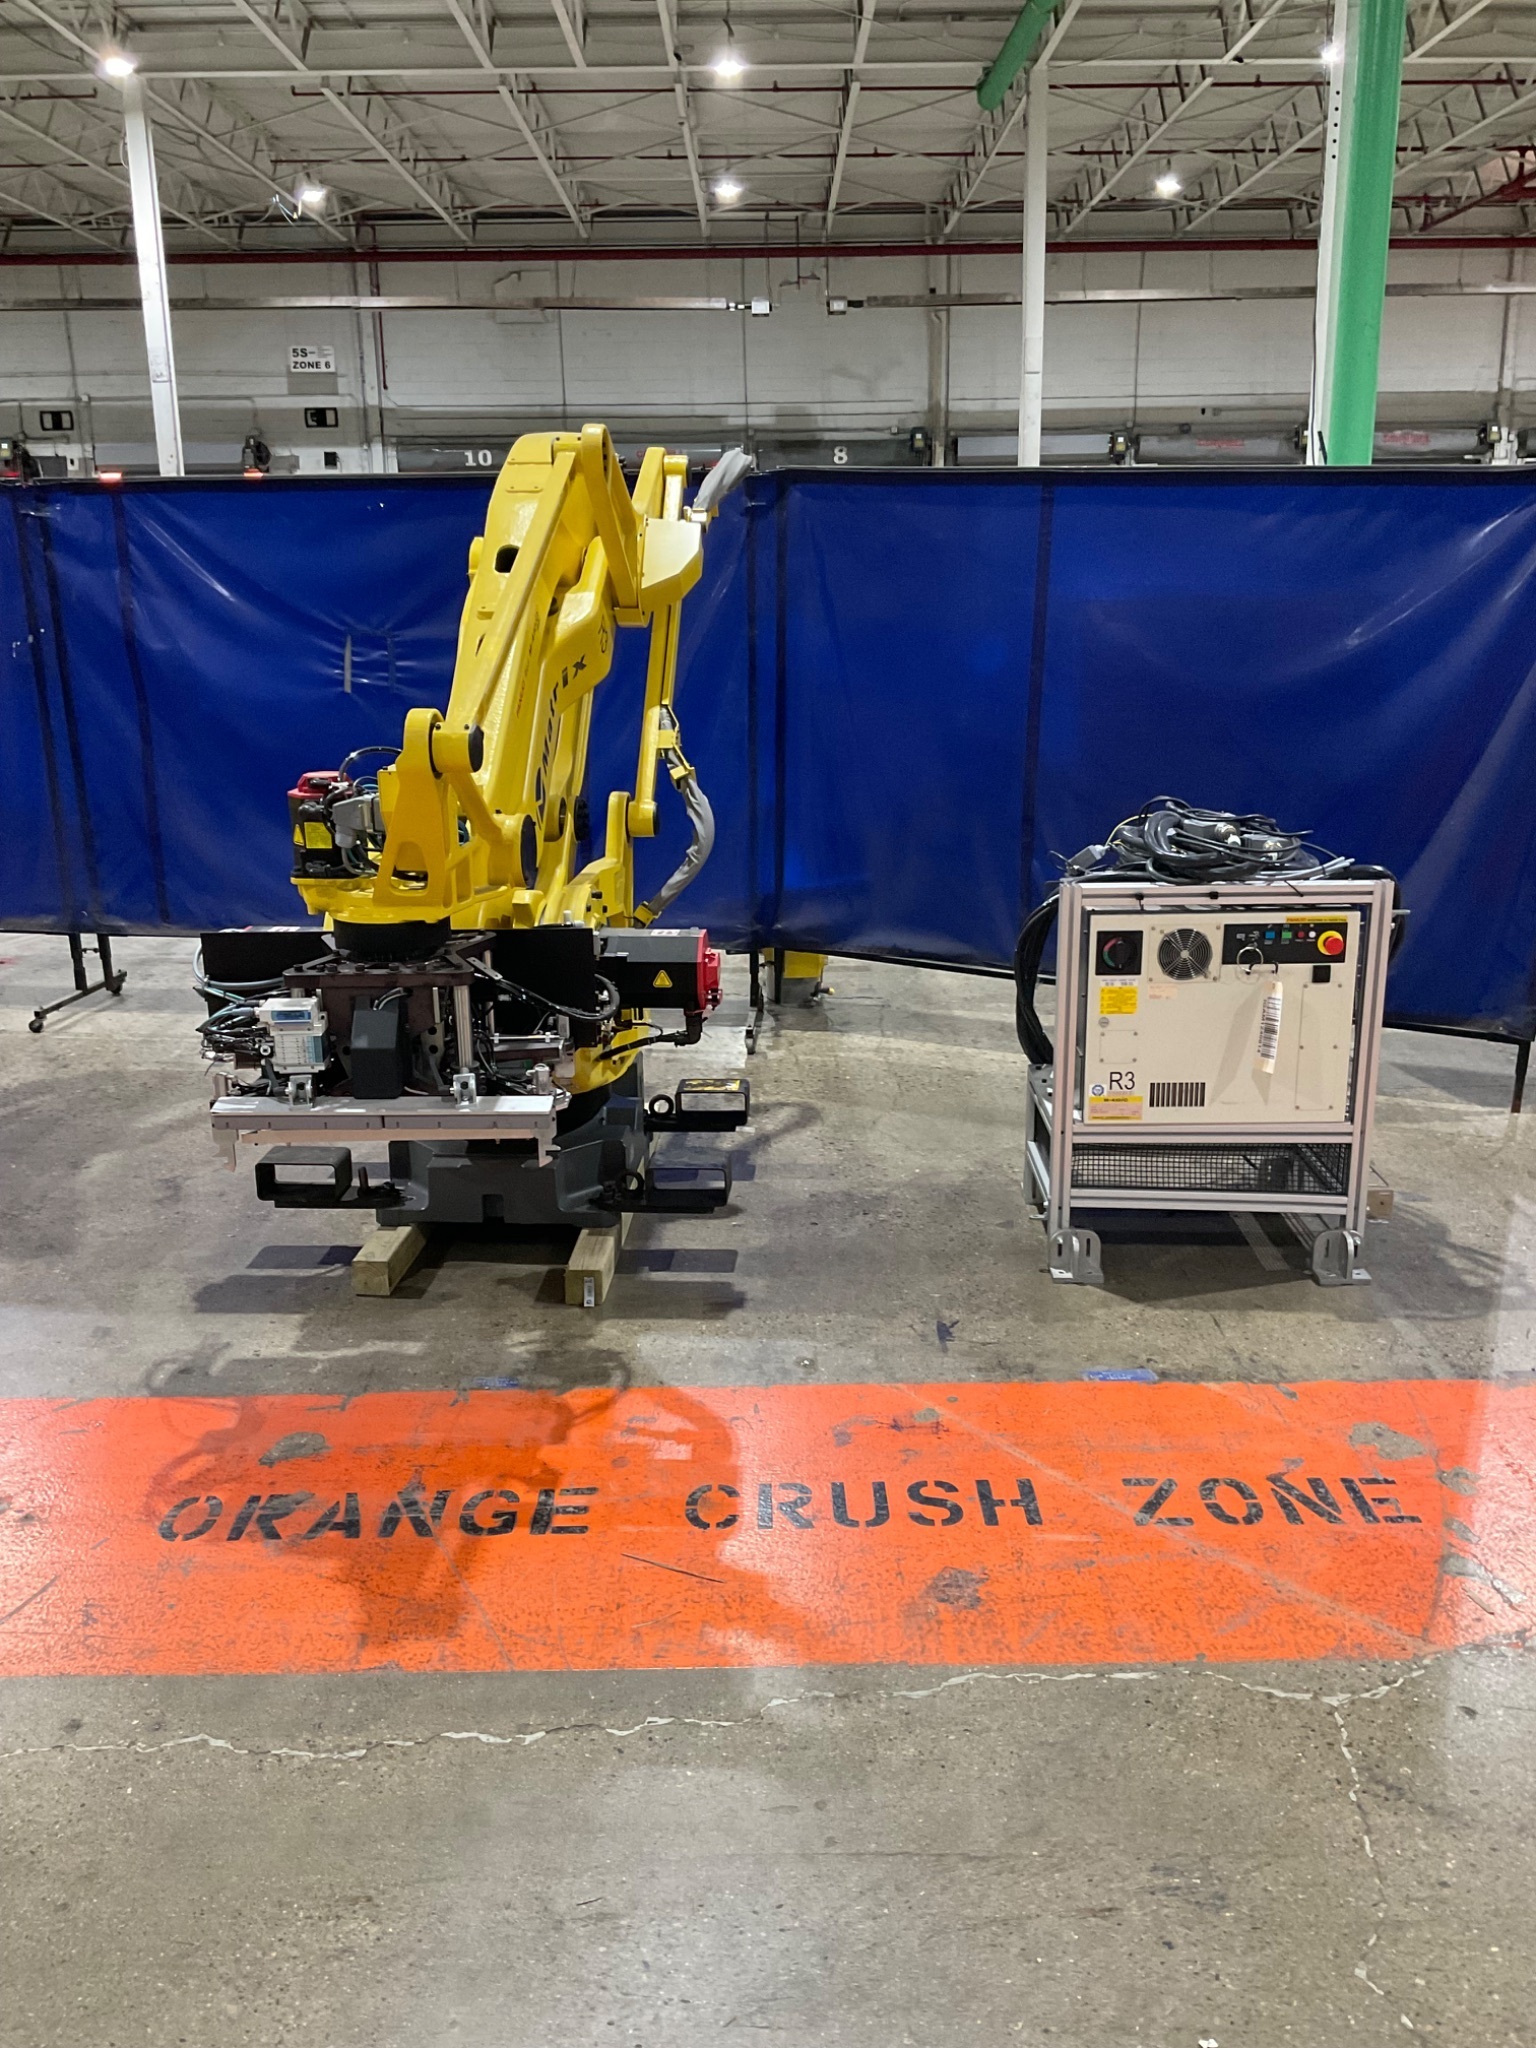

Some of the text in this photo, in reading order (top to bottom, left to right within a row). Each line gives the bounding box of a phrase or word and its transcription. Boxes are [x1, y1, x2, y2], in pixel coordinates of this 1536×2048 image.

[292, 360, 331, 370] ZONE 6
[464, 449, 493, 467] 10
[833, 445, 848, 465] 8
[1109, 1071, 1136, 1090] R3
[157, 1473, 1423, 1541] ORANGE CRUSH ZONE
